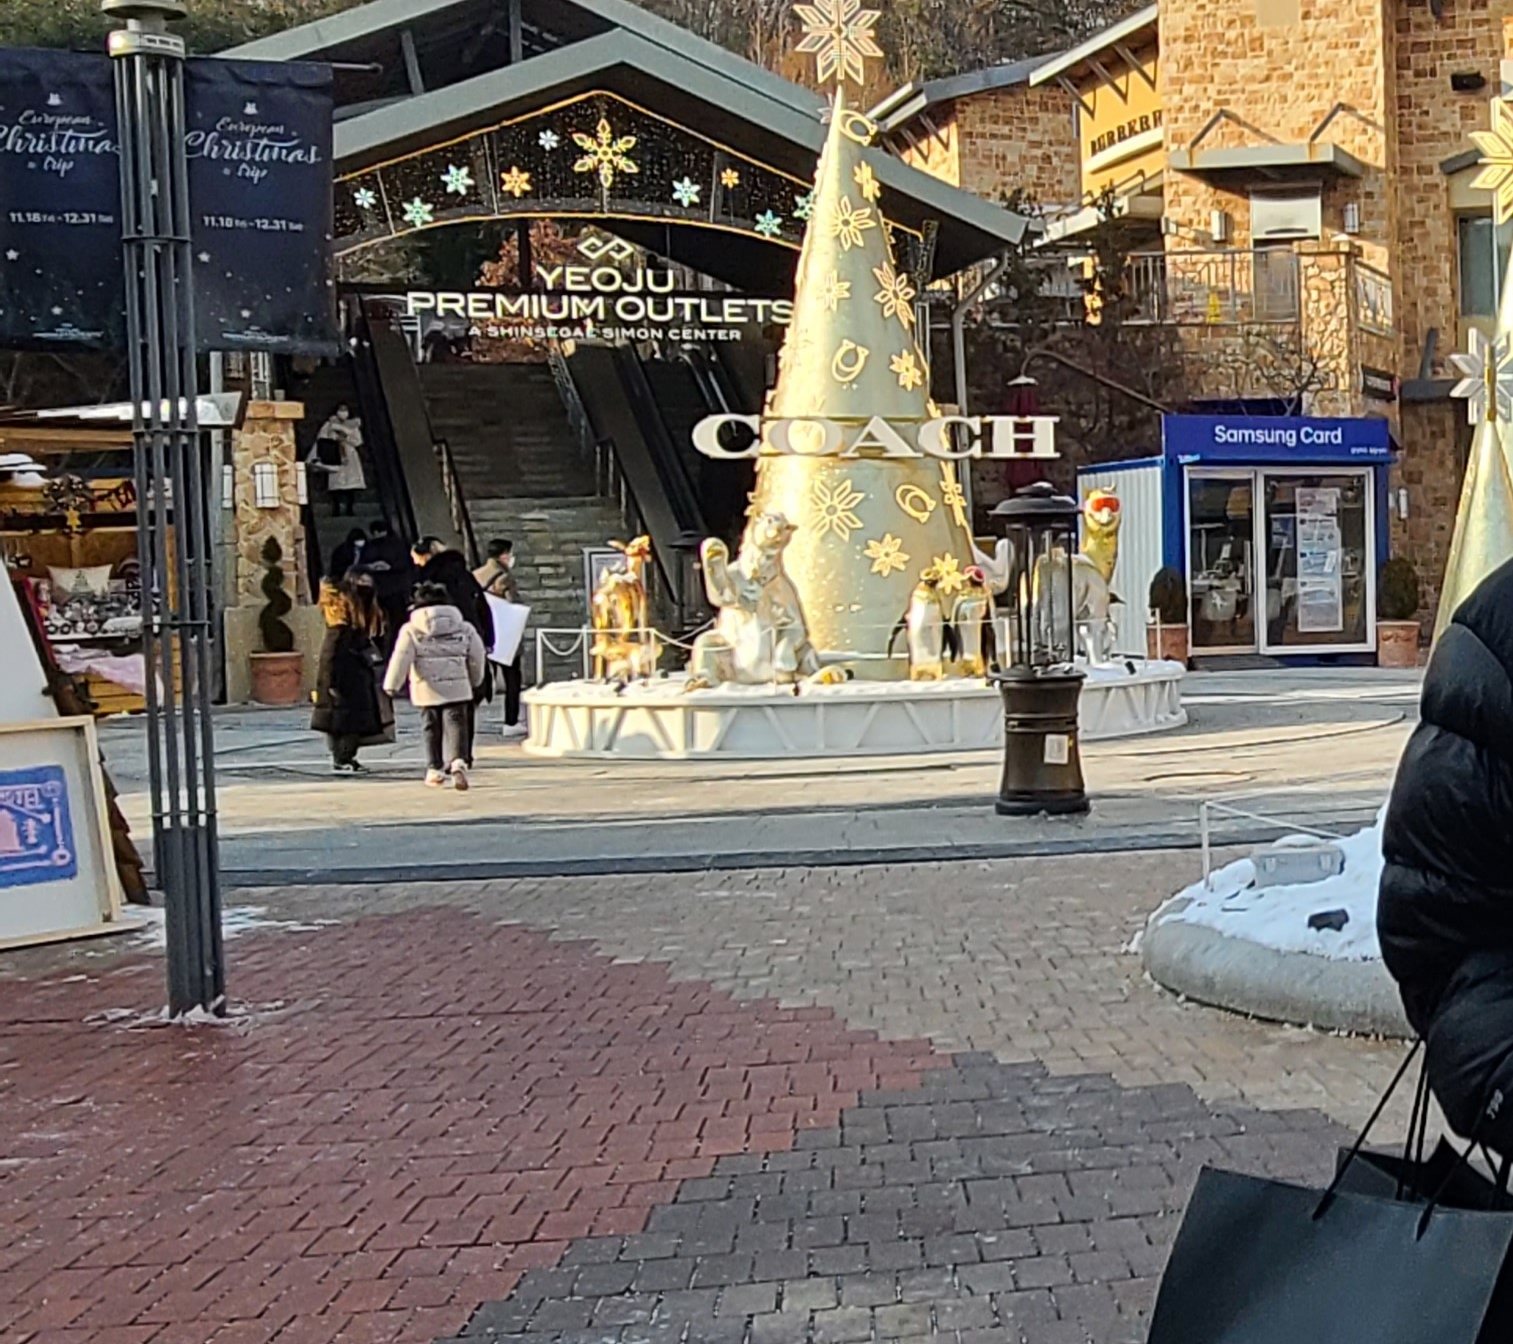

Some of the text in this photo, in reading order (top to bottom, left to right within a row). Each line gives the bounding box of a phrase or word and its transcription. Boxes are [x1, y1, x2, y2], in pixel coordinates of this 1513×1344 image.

[184, 130, 323, 164] Christmas
[536, 266, 675, 293] YEOJU
[406, 291, 794, 324] PREMIUM OUTLETS
[602, 327, 662, 339] SIMON
[668, 329, 741, 341] CENTER
[691, 413, 1061, 459] COACH
[1214, 425, 1342, 447] Samsung Card
